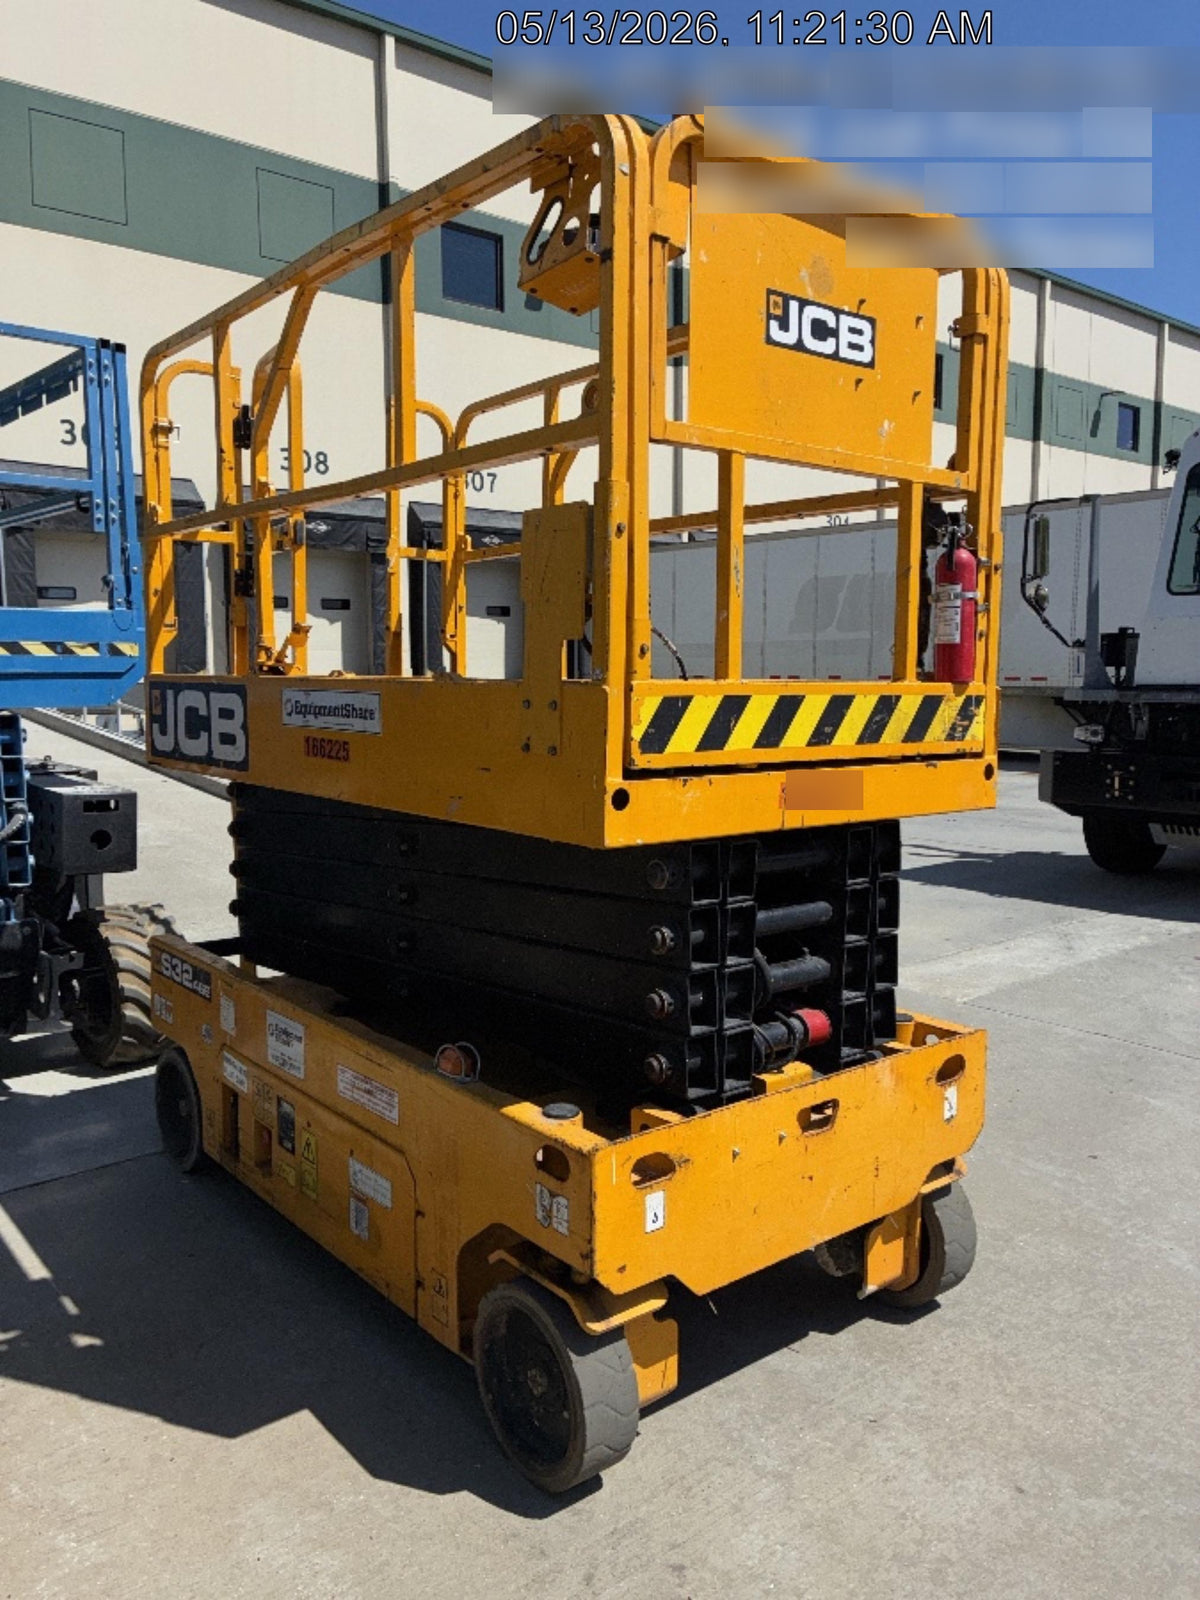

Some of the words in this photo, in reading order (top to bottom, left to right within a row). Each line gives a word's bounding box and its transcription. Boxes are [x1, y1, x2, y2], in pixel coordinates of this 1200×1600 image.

[769, 299, 874, 363] JCB
[465, 470, 497, 493] 07
[294, 700, 375, 721] EquipmentShare
[152, 688, 247, 762] JCB
[303, 735, 350, 762] 166225
